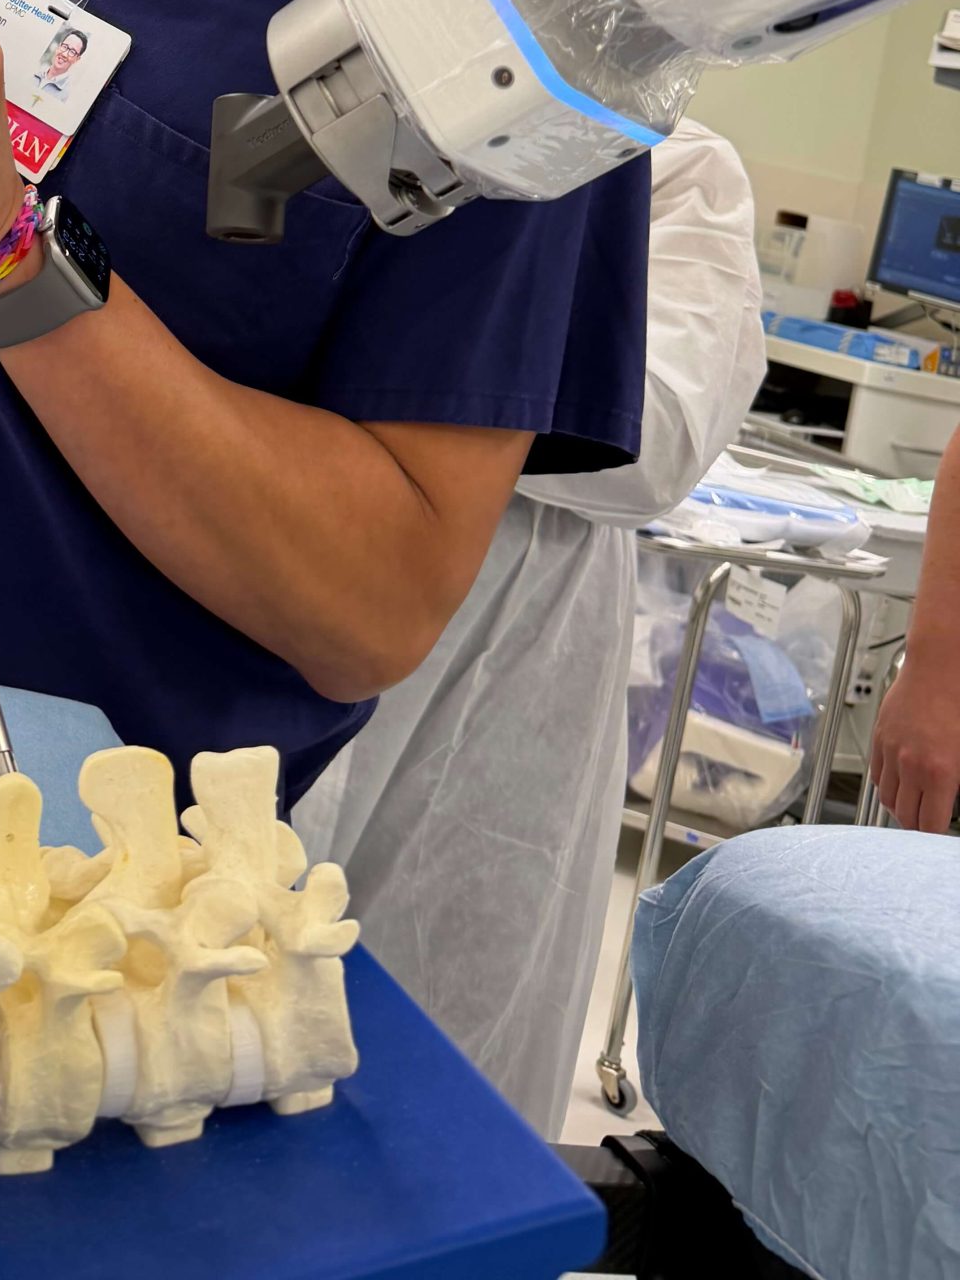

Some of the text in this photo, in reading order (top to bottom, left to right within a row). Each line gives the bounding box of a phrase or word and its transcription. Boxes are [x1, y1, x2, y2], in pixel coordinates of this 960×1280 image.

[4, 1, 27, 18] CPMC
[31, 5, 55, 25] Health
[7, 115, 51, 163] IAN
